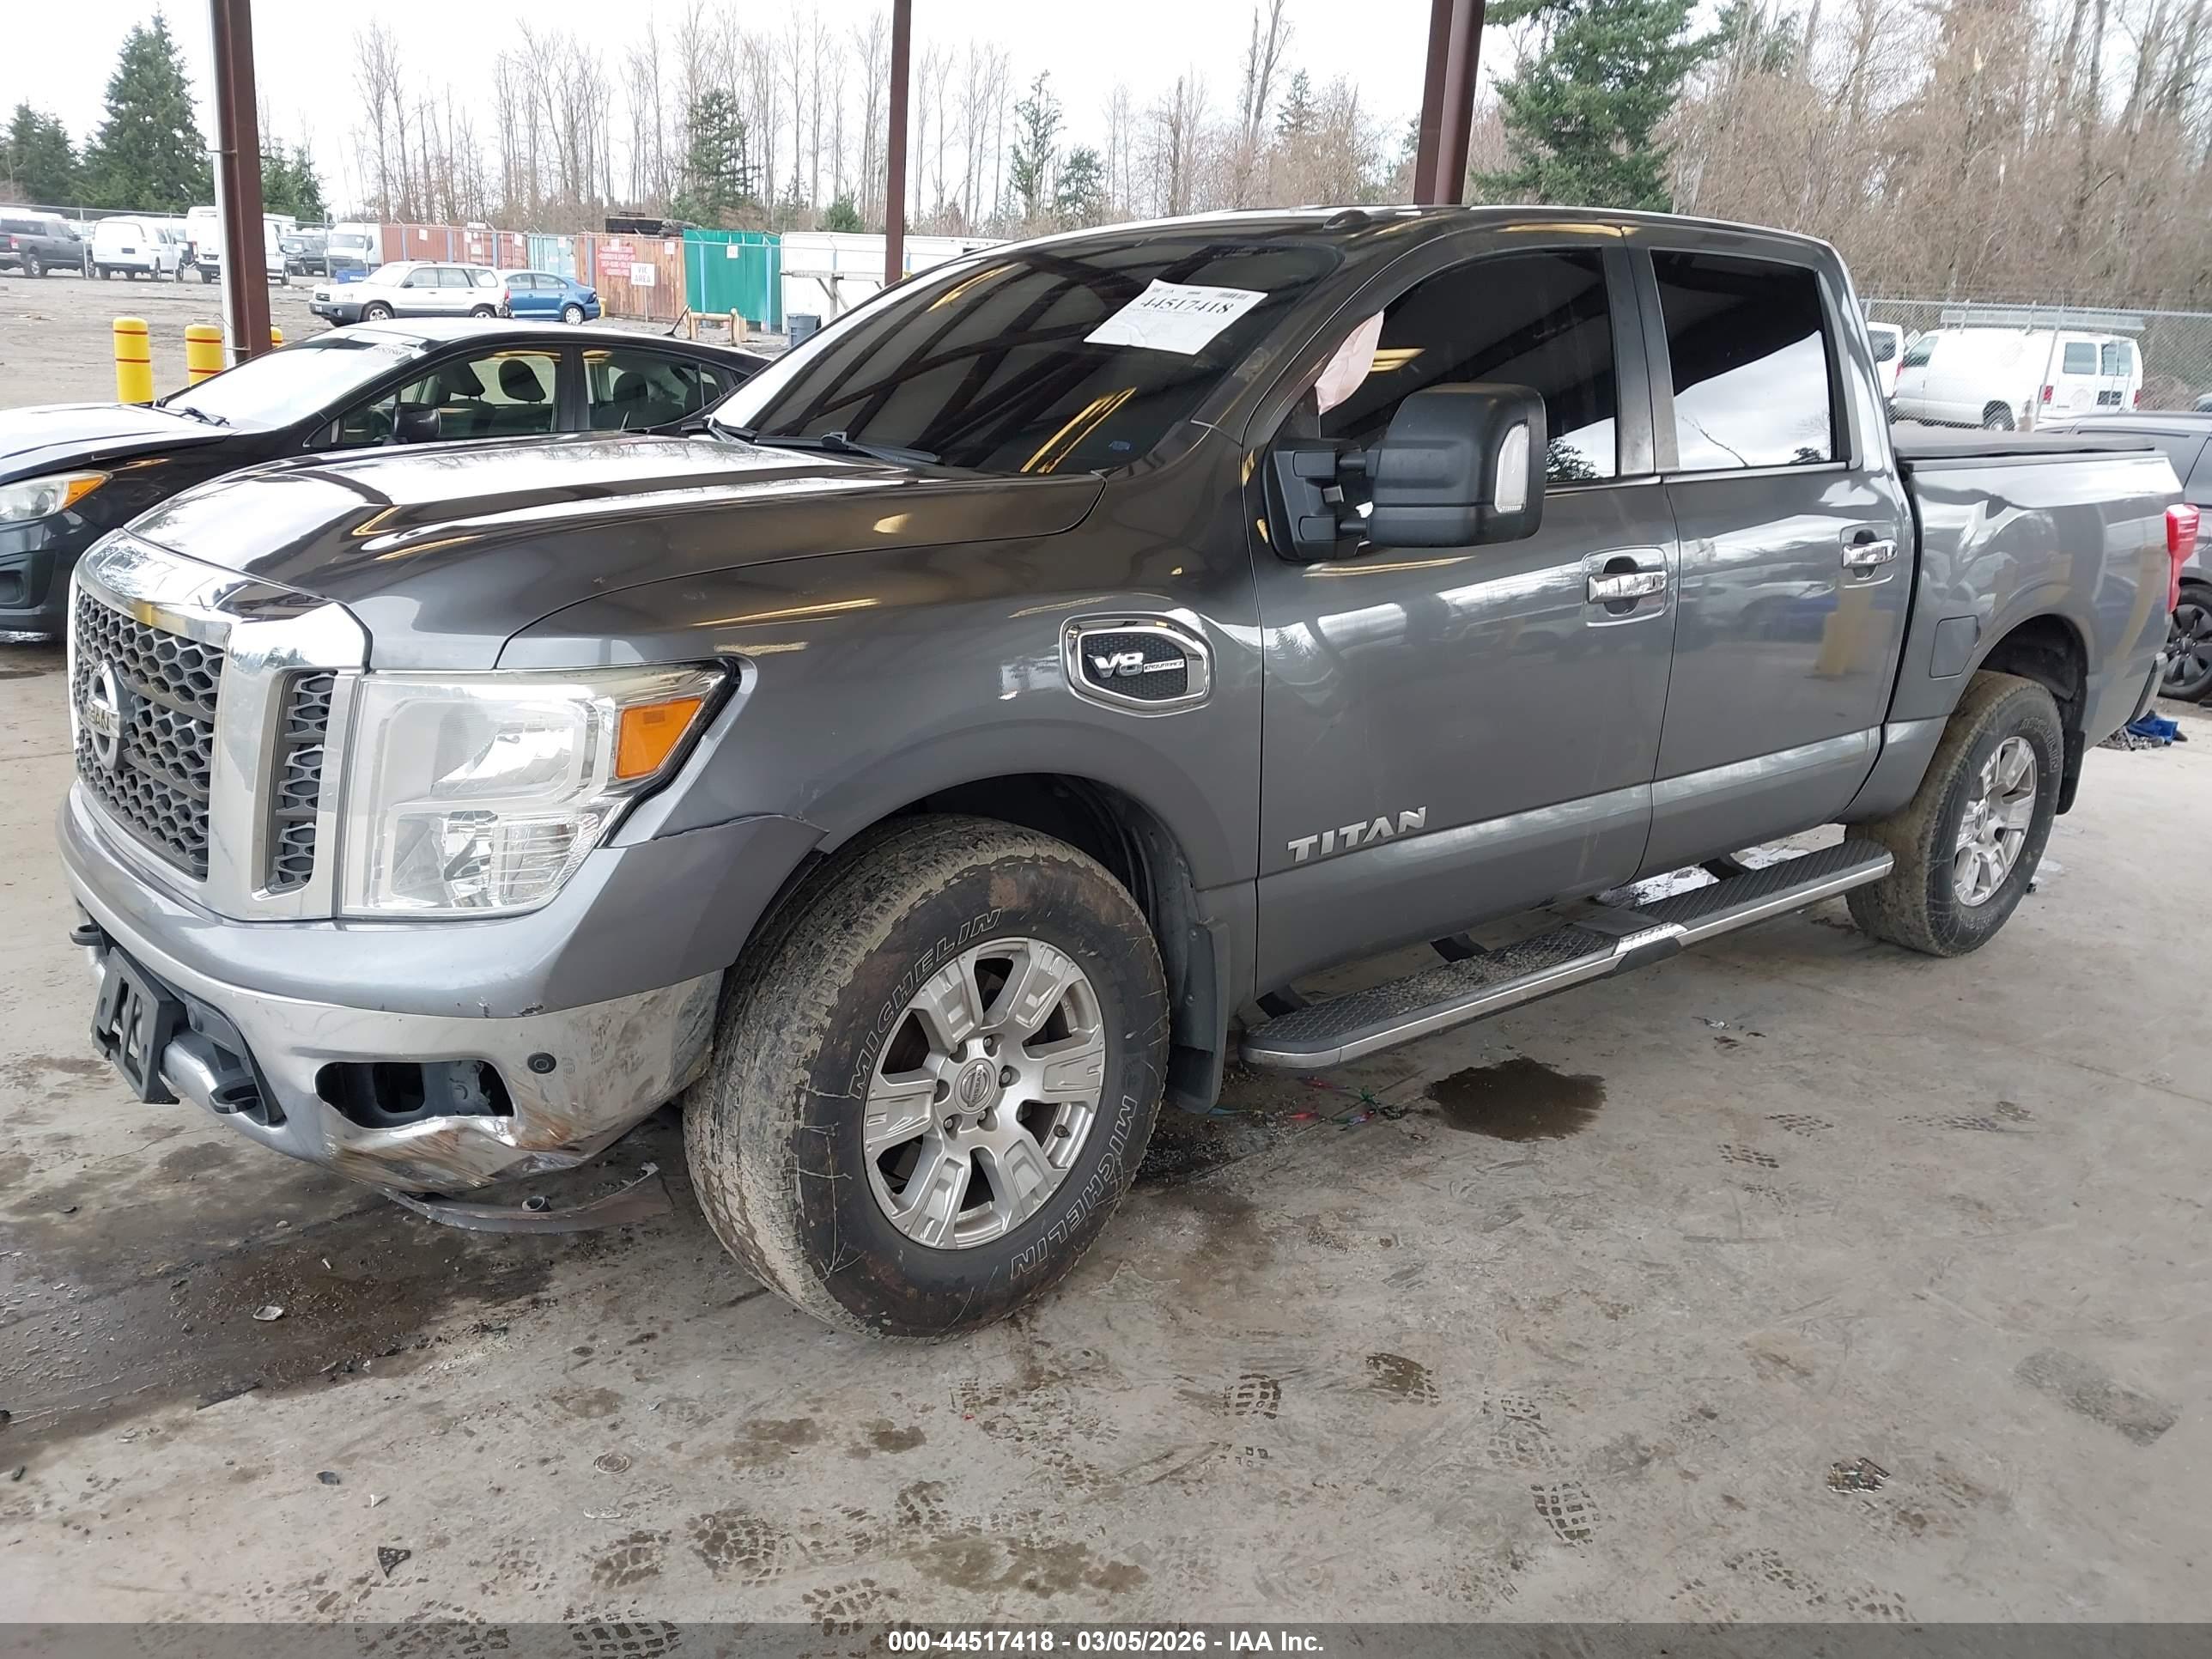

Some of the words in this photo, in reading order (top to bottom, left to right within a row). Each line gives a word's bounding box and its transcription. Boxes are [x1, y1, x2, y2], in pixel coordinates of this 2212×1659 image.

[634, 274, 651, 283] AREA
[1140, 296, 1234, 314] 44517418
[1085, 651, 1144, 678] V8
[1287, 805, 1427, 863] TITAN
[848, 908, 1002, 1100] MICHELIN
[1010, 1094, 1138, 1279] MICHELIN
